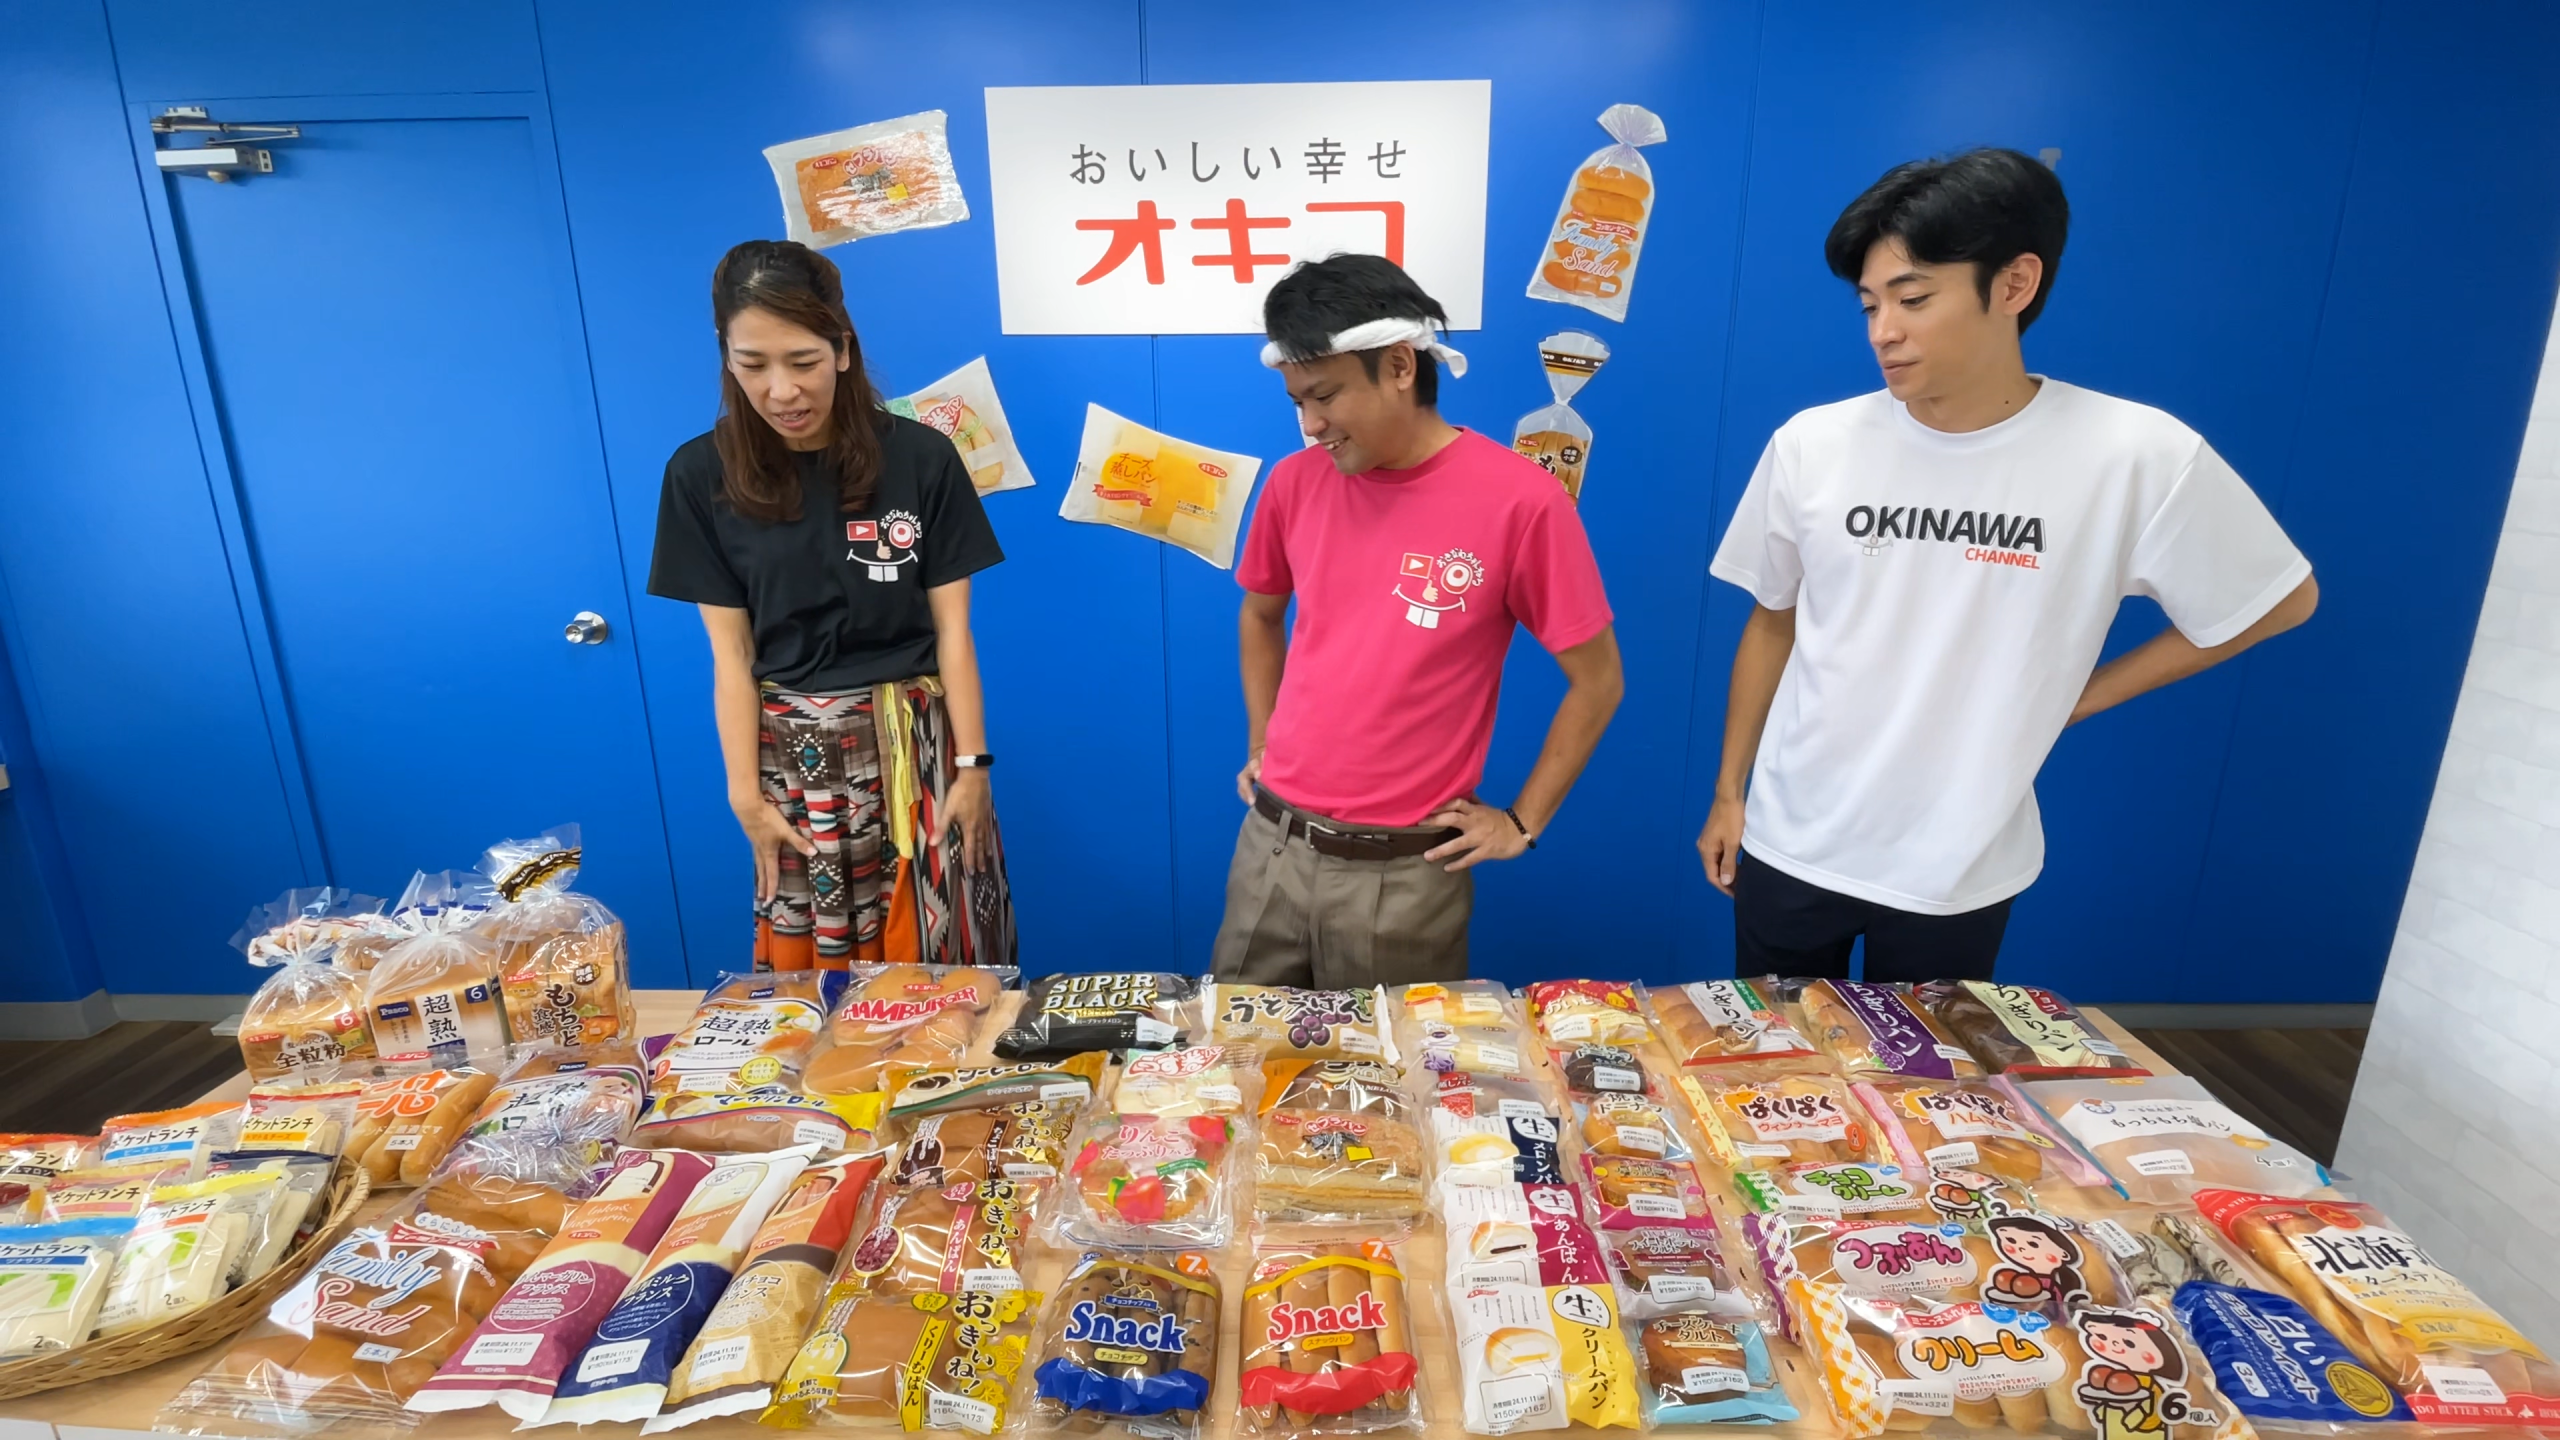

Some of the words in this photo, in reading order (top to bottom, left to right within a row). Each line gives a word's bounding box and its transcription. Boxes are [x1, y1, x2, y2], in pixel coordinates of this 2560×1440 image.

[1069, 137, 1408, 184] おいしい幸せ
[1075, 198, 1405, 286] オキコ
[1553, 219, 1620, 263] Family
[1562, 247, 1616, 278] Sand
[1110, 462, 1157, 484] 蒸しパン
[1119, 452, 1154, 470] チーズ
[1846, 505, 2046, 553] OKINAWA
[1965, 547, 2041, 570] CHANNEL
[470, 988, 483, 999] 6
[750, 990, 774, 998] Pasco
[1051, 974, 1155, 994] SUPER
[380, 1006, 410, 1017] Pasco
[840, 986, 979, 1023] HAMBURGER
[1041, 989, 1154, 1010] BLACK
[340, 1013, 354, 1026] 6
[422, 994, 457, 1043] 超熟
[534, 1008, 557, 1035] 食感
[545, 983, 585, 1047] もちっと
[697, 1016, 772, 1035] 超熟
[694, 1036, 757, 1046] ロール
[276, 1043, 345, 1069] 全粒粉
[957, 1060, 1067, 1082] コーヒーロール
[714, 1094, 827, 1106] マーガリンロール
[1600, 1102, 1663, 1114] ドーナツ
[1741, 1094, 1837, 1120] ぱくぱく
[1918, 1093, 2014, 1122] ぱくぱく
[1305, 1117, 1368, 1136] ゼブラパン
[1521, 1117, 1552, 1138] 生
[1949, 1113, 2015, 1132] ハムマヨ
[1119, 1126, 1181, 1144] りんご
[1102, 1145, 1197, 1160] たっぷりパン
[1802, 1168, 1873, 1187] チョコ
[1540, 1191, 1569, 1210] 生
[1831, 1183, 1906, 1200] クリーム
[981, 1179, 1020, 1265] おっきいね!
[943, 1218, 966, 1273] あんぱん
[1554, 1218, 1580, 1284] あんぱん
[1837, 1231, 1964, 1276] つぶあん
[320, 1227, 442, 1309] Family
[521, 1283, 569, 1297] フランス
[289, 1277, 433, 1337] Sand
[1267, 1291, 1388, 1343] Snack
[1563, 1294, 1600, 1323] 生
[1064, 1301, 1188, 1353] Snack
[1653, 1316, 1743, 1335] チーズケーキ
[1679, 1329, 1724, 1343] タルト
[948, 1291, 998, 1394] おっきいね!
[1307, 1336, 1350, 1346] スナックパン
[1912, 1329, 2045, 1372] クリーム
[2215, 1291, 2321, 1405] チョコツイスト
[2263, 1314, 2326, 1366] 白い
[904, 1325, 940, 1406] くりーむぱん
[1100, 1352, 1142, 1362] チョコチップ
[1582, 1328, 1609, 1410] クリームパン
[2161, 1392, 2218, 1424] 6個入
[2438, 1405, 2480, 1416] BUTTER
[2483, 1407, 2514, 1417] STICK
